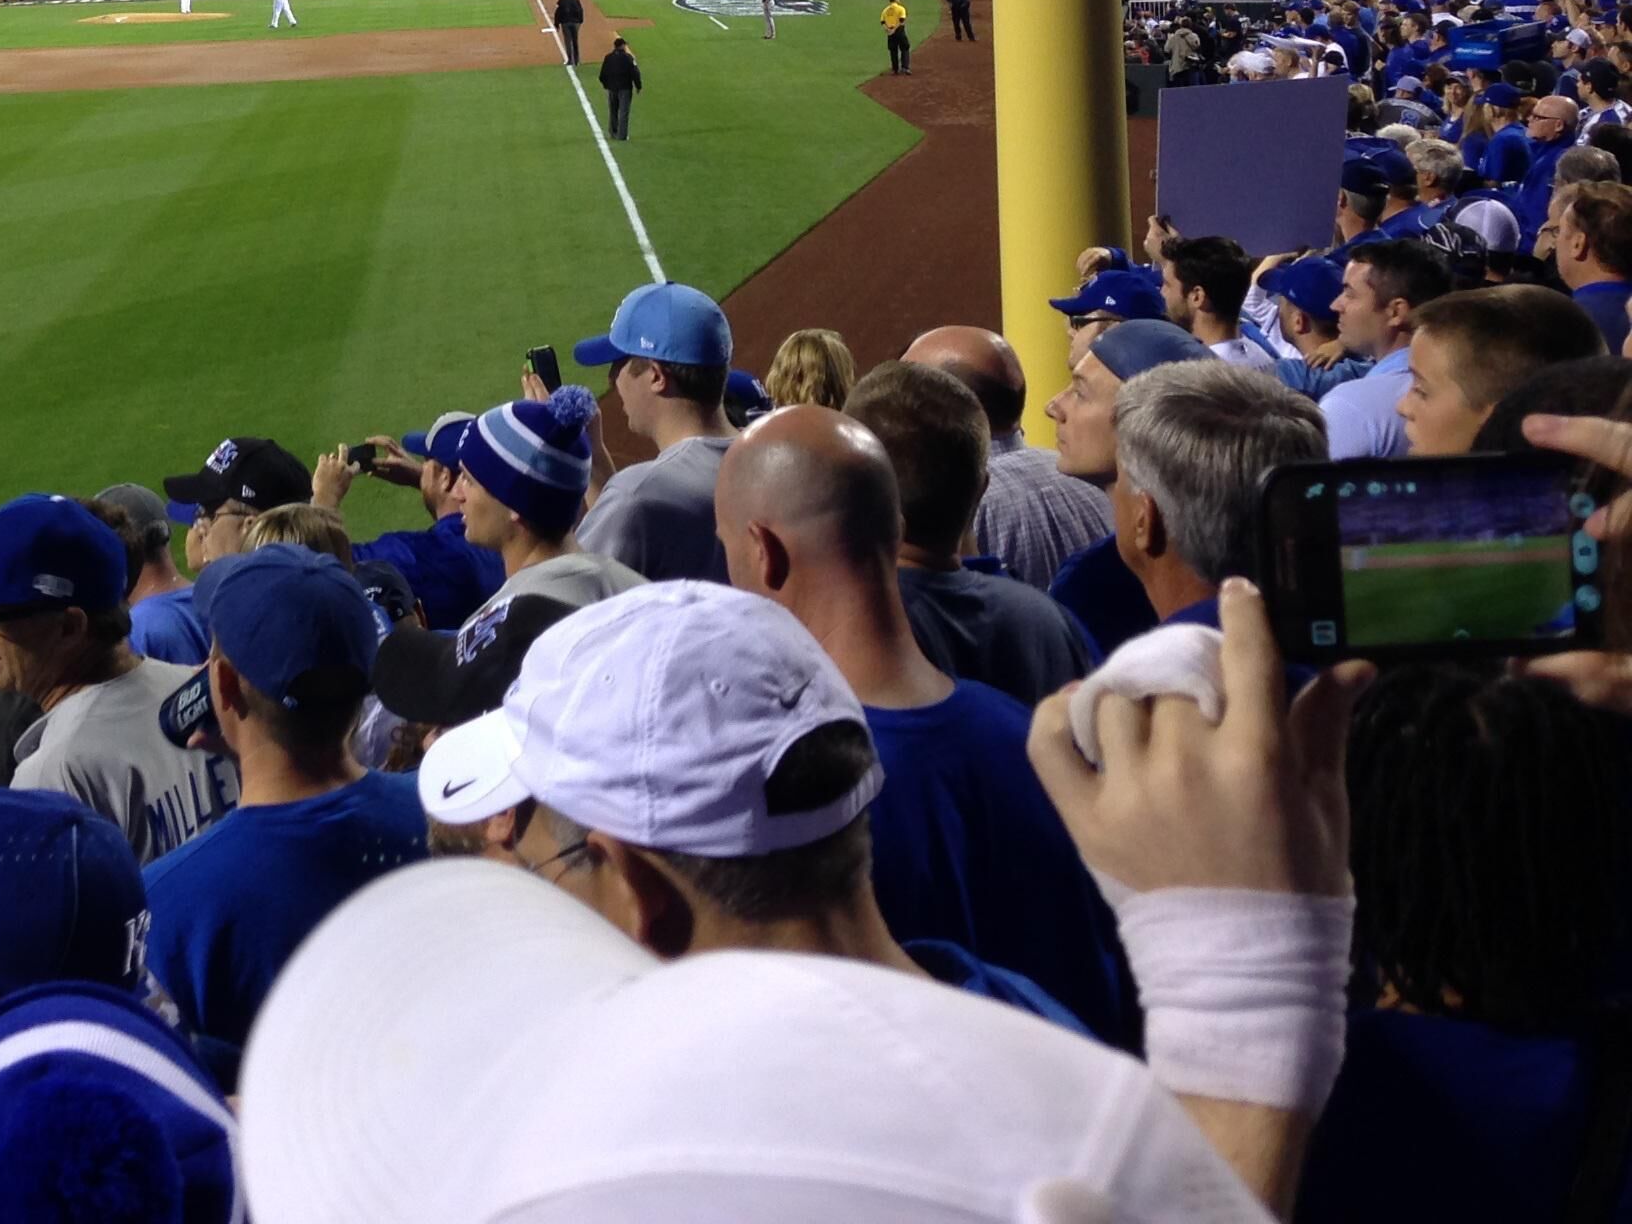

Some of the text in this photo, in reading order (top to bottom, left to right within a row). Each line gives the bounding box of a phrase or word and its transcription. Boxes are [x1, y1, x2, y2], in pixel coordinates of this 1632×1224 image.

[178, 695, 210, 731] LIGHT
[179, 681, 203, 709] BUD
[146, 752, 243, 858] MILLE
